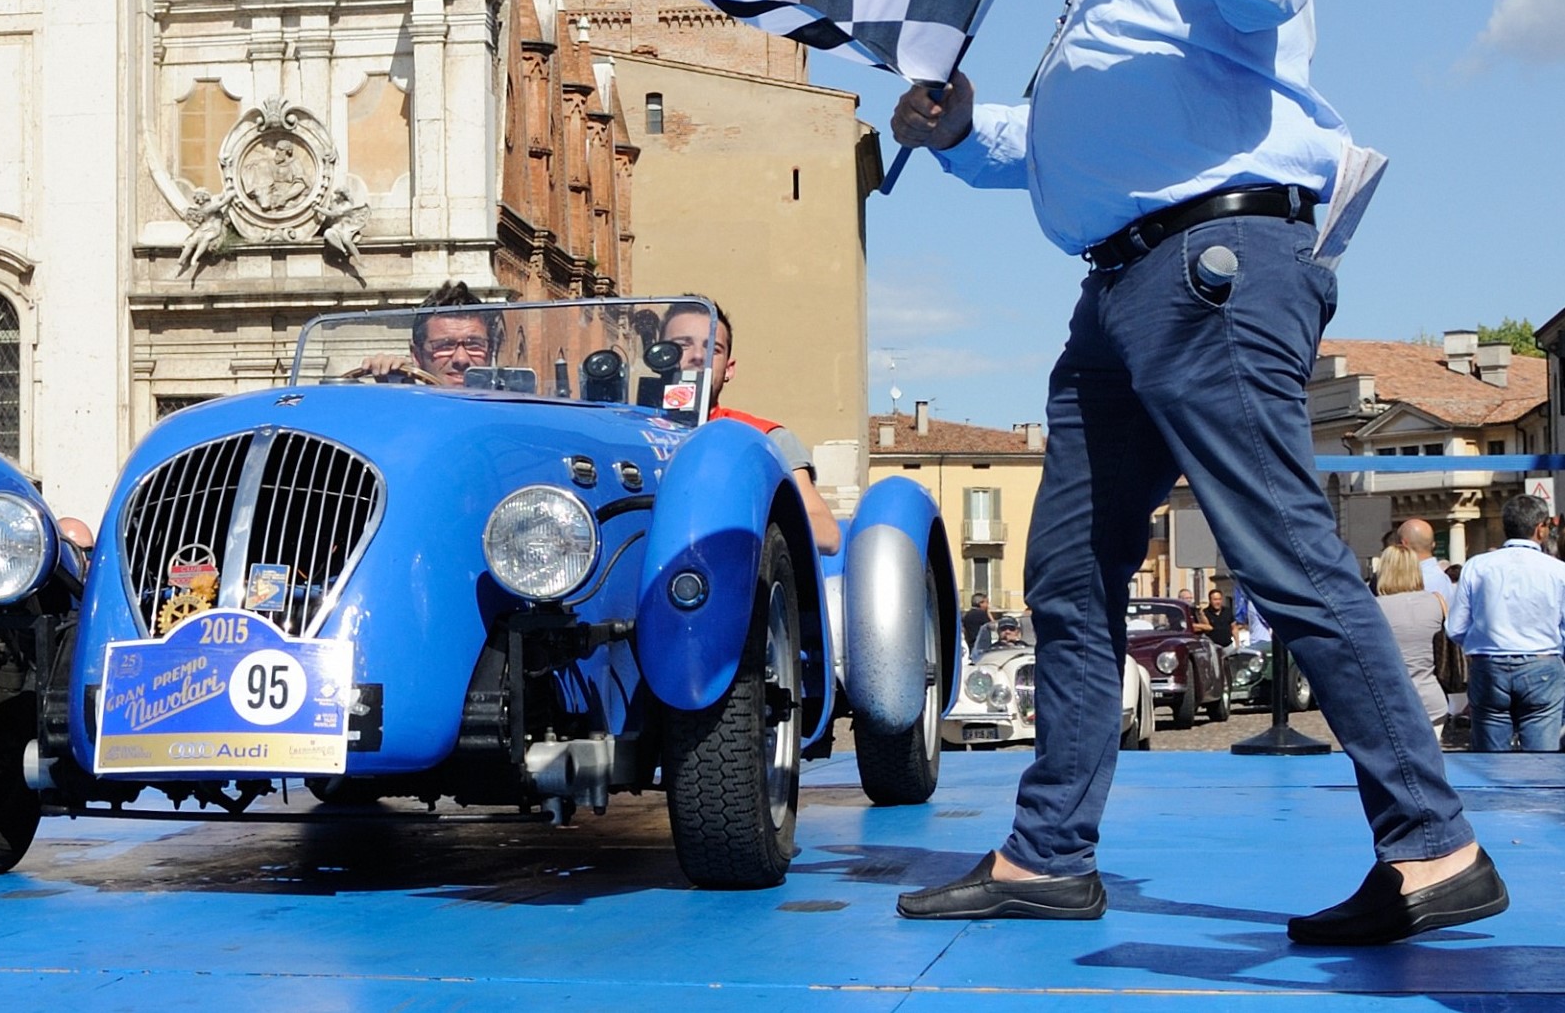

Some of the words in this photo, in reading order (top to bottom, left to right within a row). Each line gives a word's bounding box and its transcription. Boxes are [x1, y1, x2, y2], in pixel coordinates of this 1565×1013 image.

[200, 618, 248, 644] 2015
[121, 654, 136, 667] 25
[106, 683, 145, 712] GRAN
[153, 656, 207, 690] PREMIO
[124, 669, 226, 731] Nuvolari
[247, 664, 289, 709] 95
[216, 743, 269, 758] Audi
